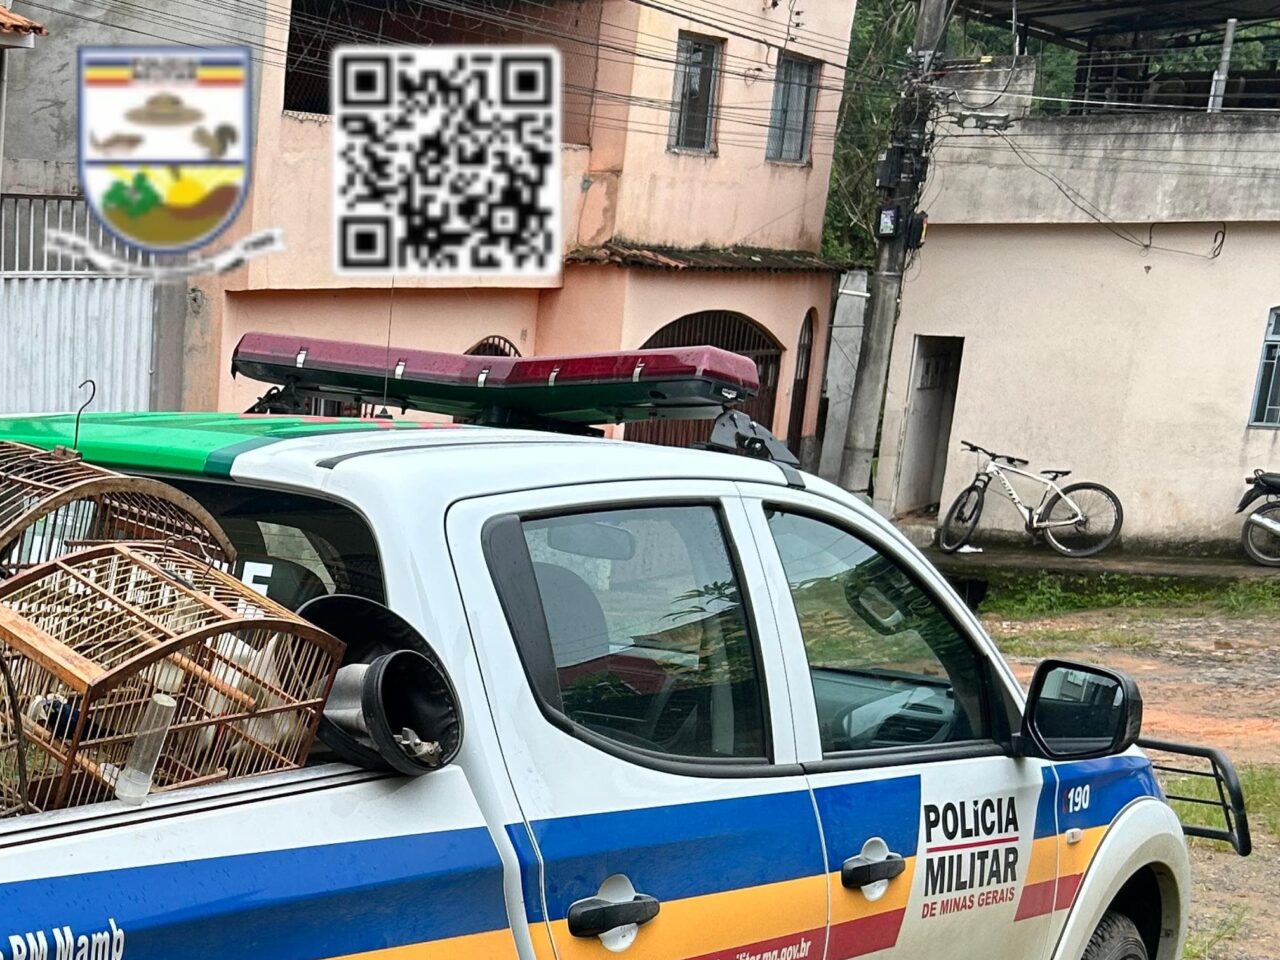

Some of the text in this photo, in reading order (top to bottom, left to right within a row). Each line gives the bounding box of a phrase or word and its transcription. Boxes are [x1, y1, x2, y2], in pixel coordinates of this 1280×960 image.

[1067, 784, 1090, 813] 190
[923, 796, 1019, 843] POLÍCIA
[923, 846, 1019, 897] MILITAR
[921, 886, 1015, 919] DE MINAS GERAIS
